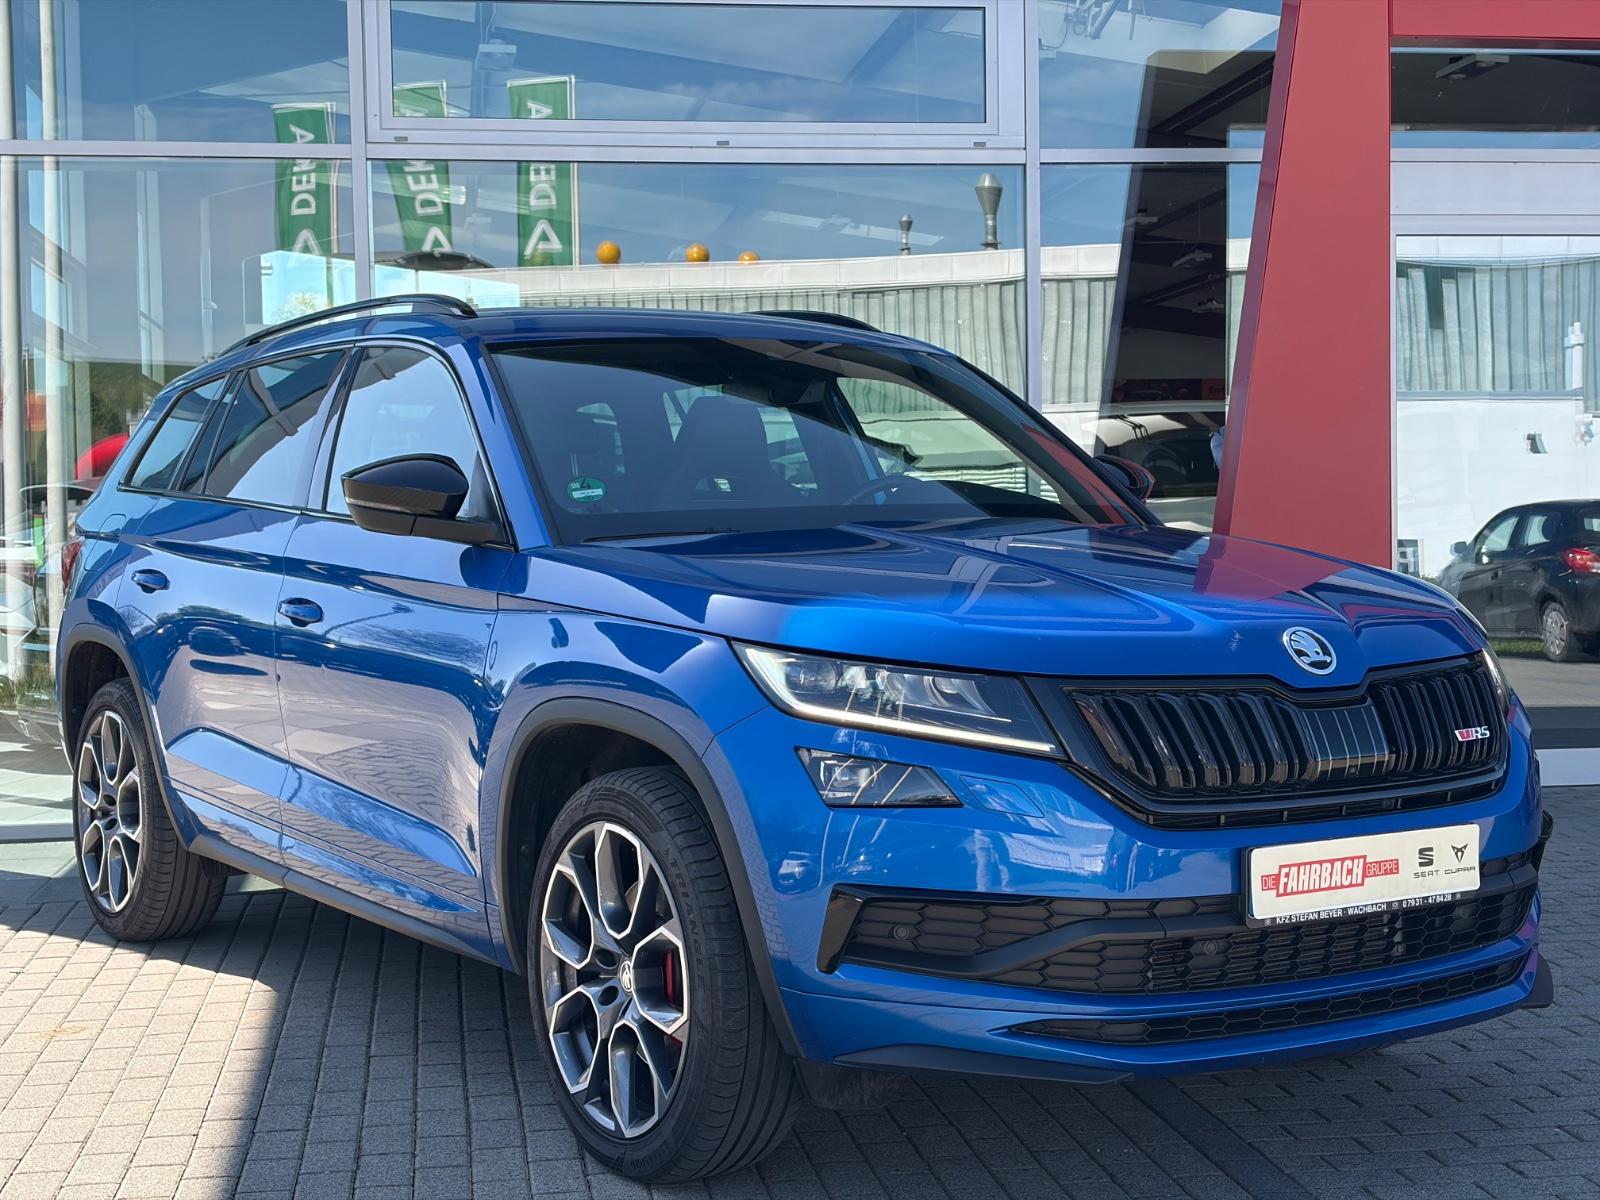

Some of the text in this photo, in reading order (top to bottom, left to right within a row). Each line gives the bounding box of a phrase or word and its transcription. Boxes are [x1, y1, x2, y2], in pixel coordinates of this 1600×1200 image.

[1262, 857, 1398, 894] DIE FAHRBACH GRUPPE
[1413, 869, 1441, 879] SEAT
[1444, 866, 1476, 876] CUPRA
[1276, 915, 1290, 925] KFZ
[1291, 912, 1318, 922] STEFAN
[1320, 909, 1343, 919] BEYER
[1347, 902, 1387, 915] WACHBACH
